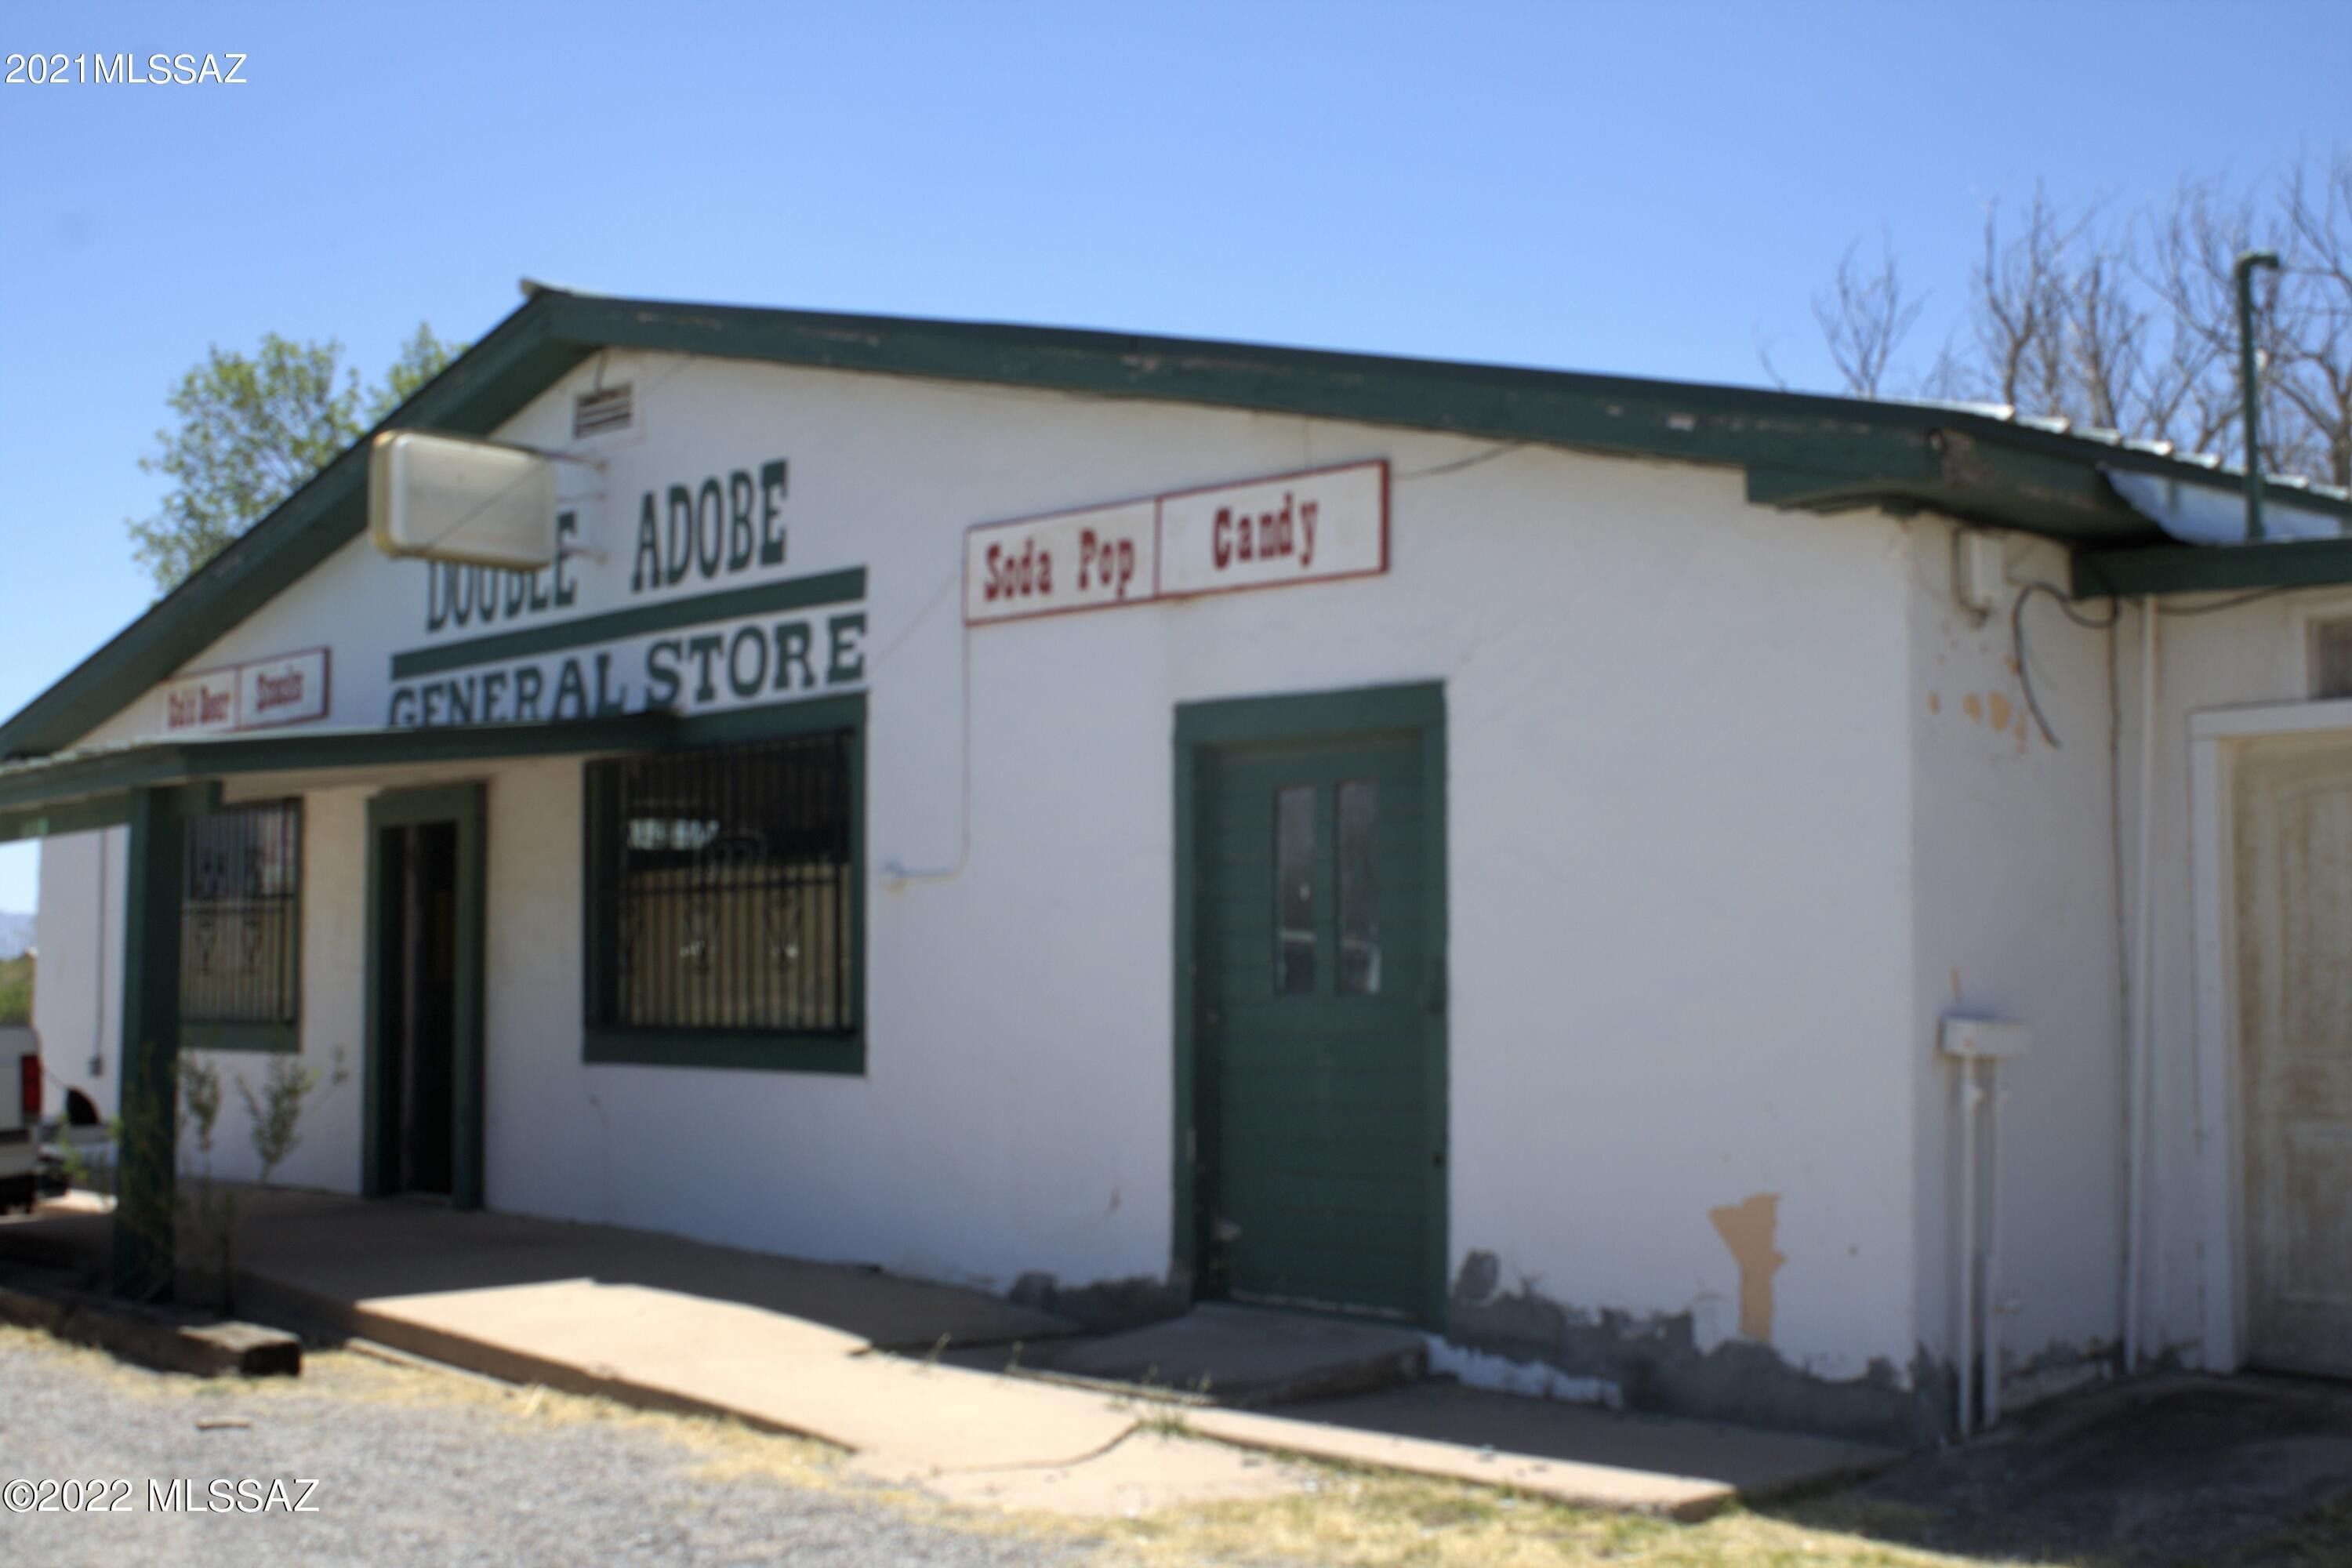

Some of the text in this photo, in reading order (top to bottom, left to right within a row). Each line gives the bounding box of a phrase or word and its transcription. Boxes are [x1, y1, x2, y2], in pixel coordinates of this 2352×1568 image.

[632, 459, 788, 593] ADOBE
[985, 528, 1134, 601] Soda Pop
[1212, 491, 1319, 571] Candy
[389, 652, 626, 728] GENERAL
[646, 612, 866, 710] STORE
